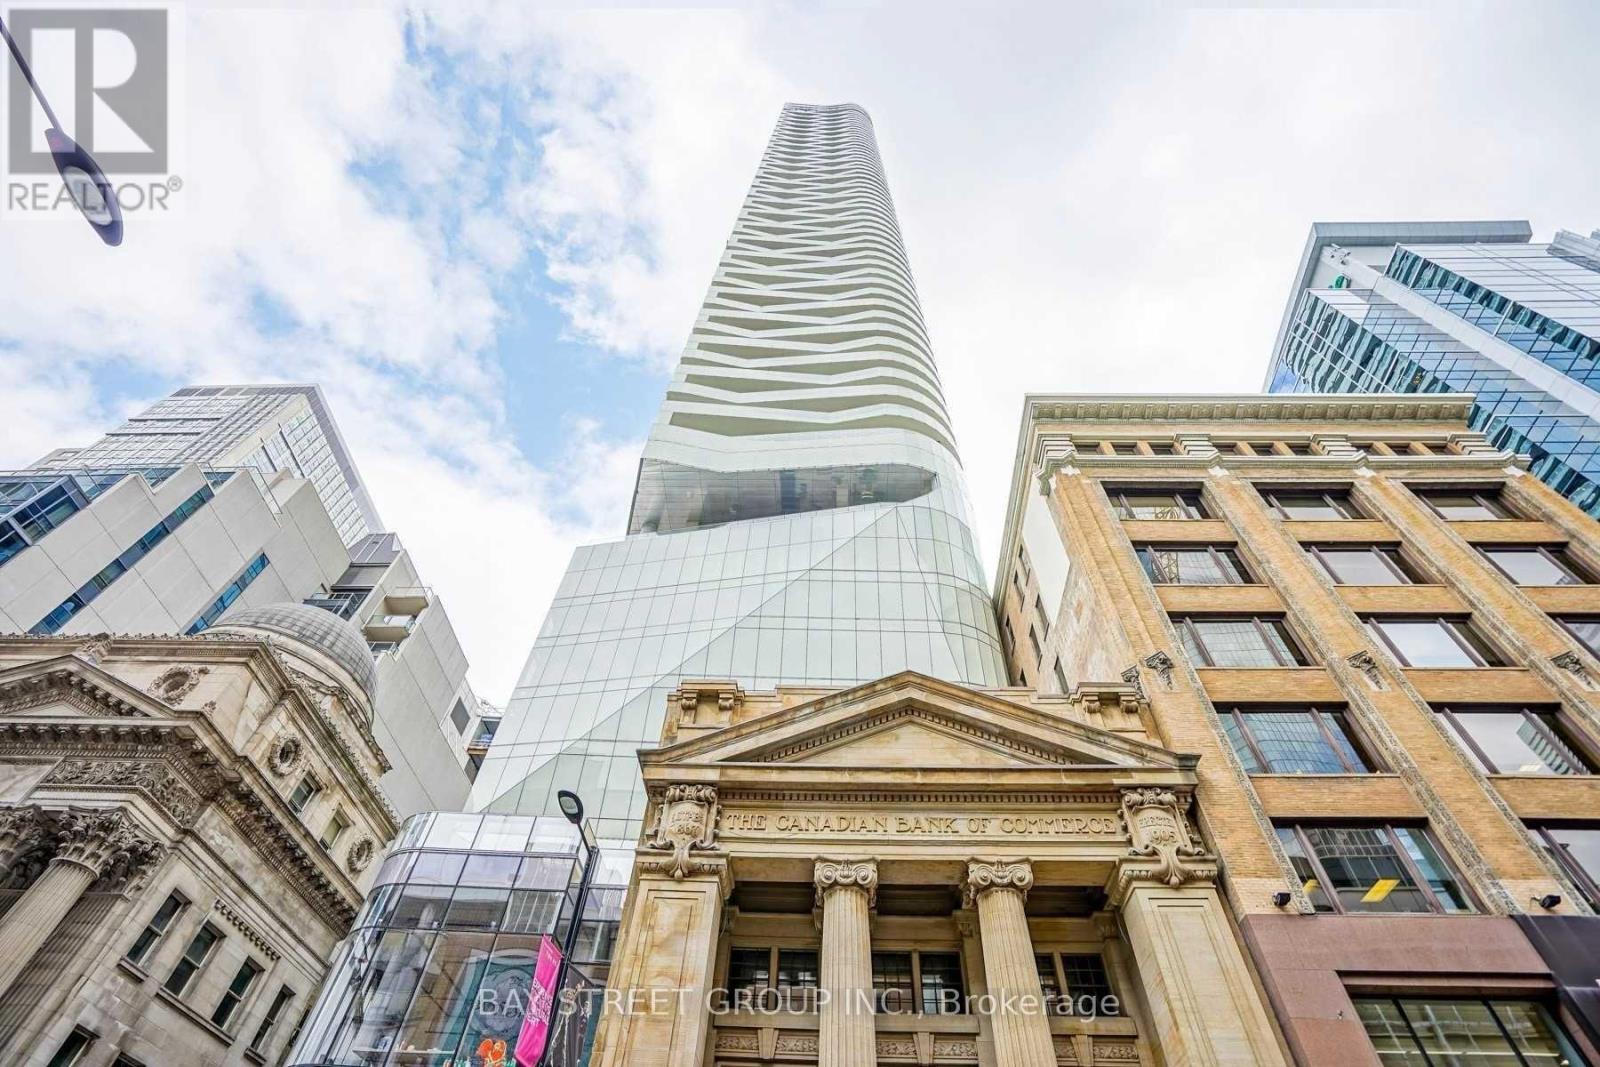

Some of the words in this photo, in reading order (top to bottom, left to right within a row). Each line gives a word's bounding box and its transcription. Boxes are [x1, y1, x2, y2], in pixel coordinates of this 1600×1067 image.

[726, 814, 767, 832] THE
[775, 815, 888, 833] CANADIAN
[895, 816, 959, 834] BANK
[966, 817, 992, 834] OF
[1000, 817, 1117, 835] COMMERCE
